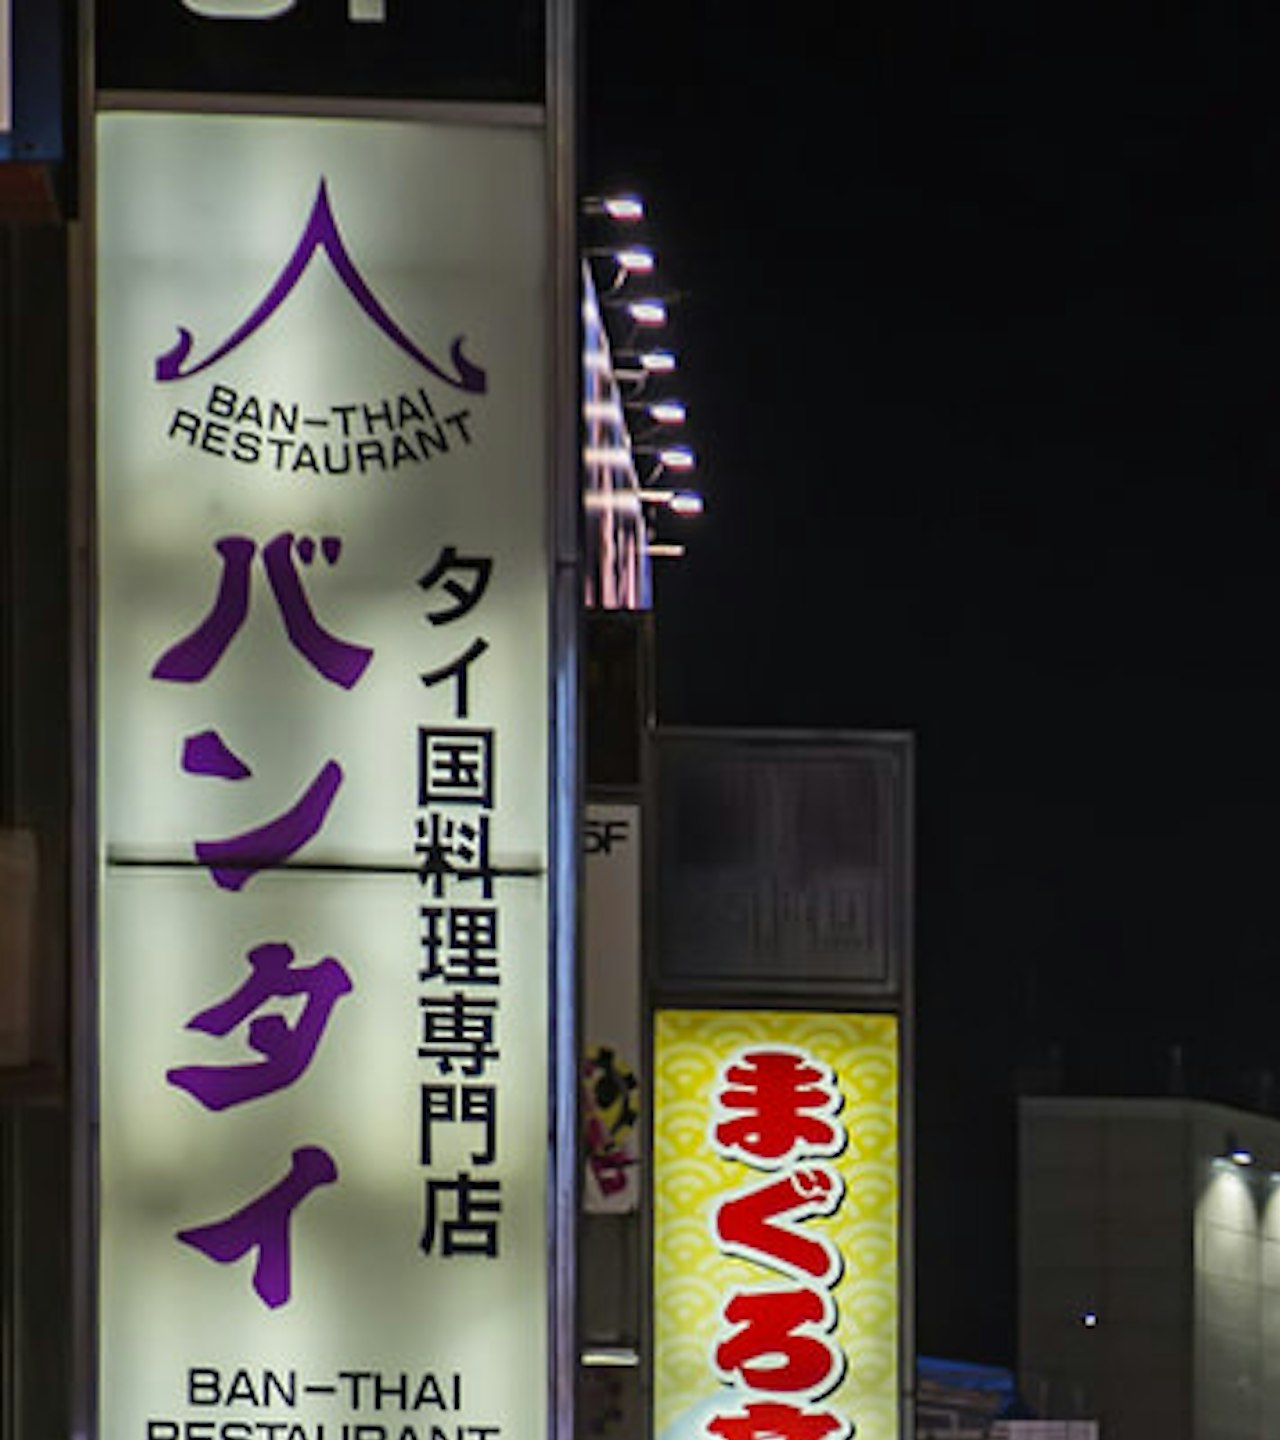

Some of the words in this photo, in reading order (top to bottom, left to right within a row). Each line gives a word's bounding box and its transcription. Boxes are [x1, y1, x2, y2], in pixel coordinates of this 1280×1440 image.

[167, 408, 474, 476] RESTAURANT
[206, 384, 436, 436] BAN-THAI
[150, 532, 374, 1310] バンタイ
[415, 545, 501, 1258] タイ国料理専門店
[187, 1368, 462, 1412] BAN-THAI
